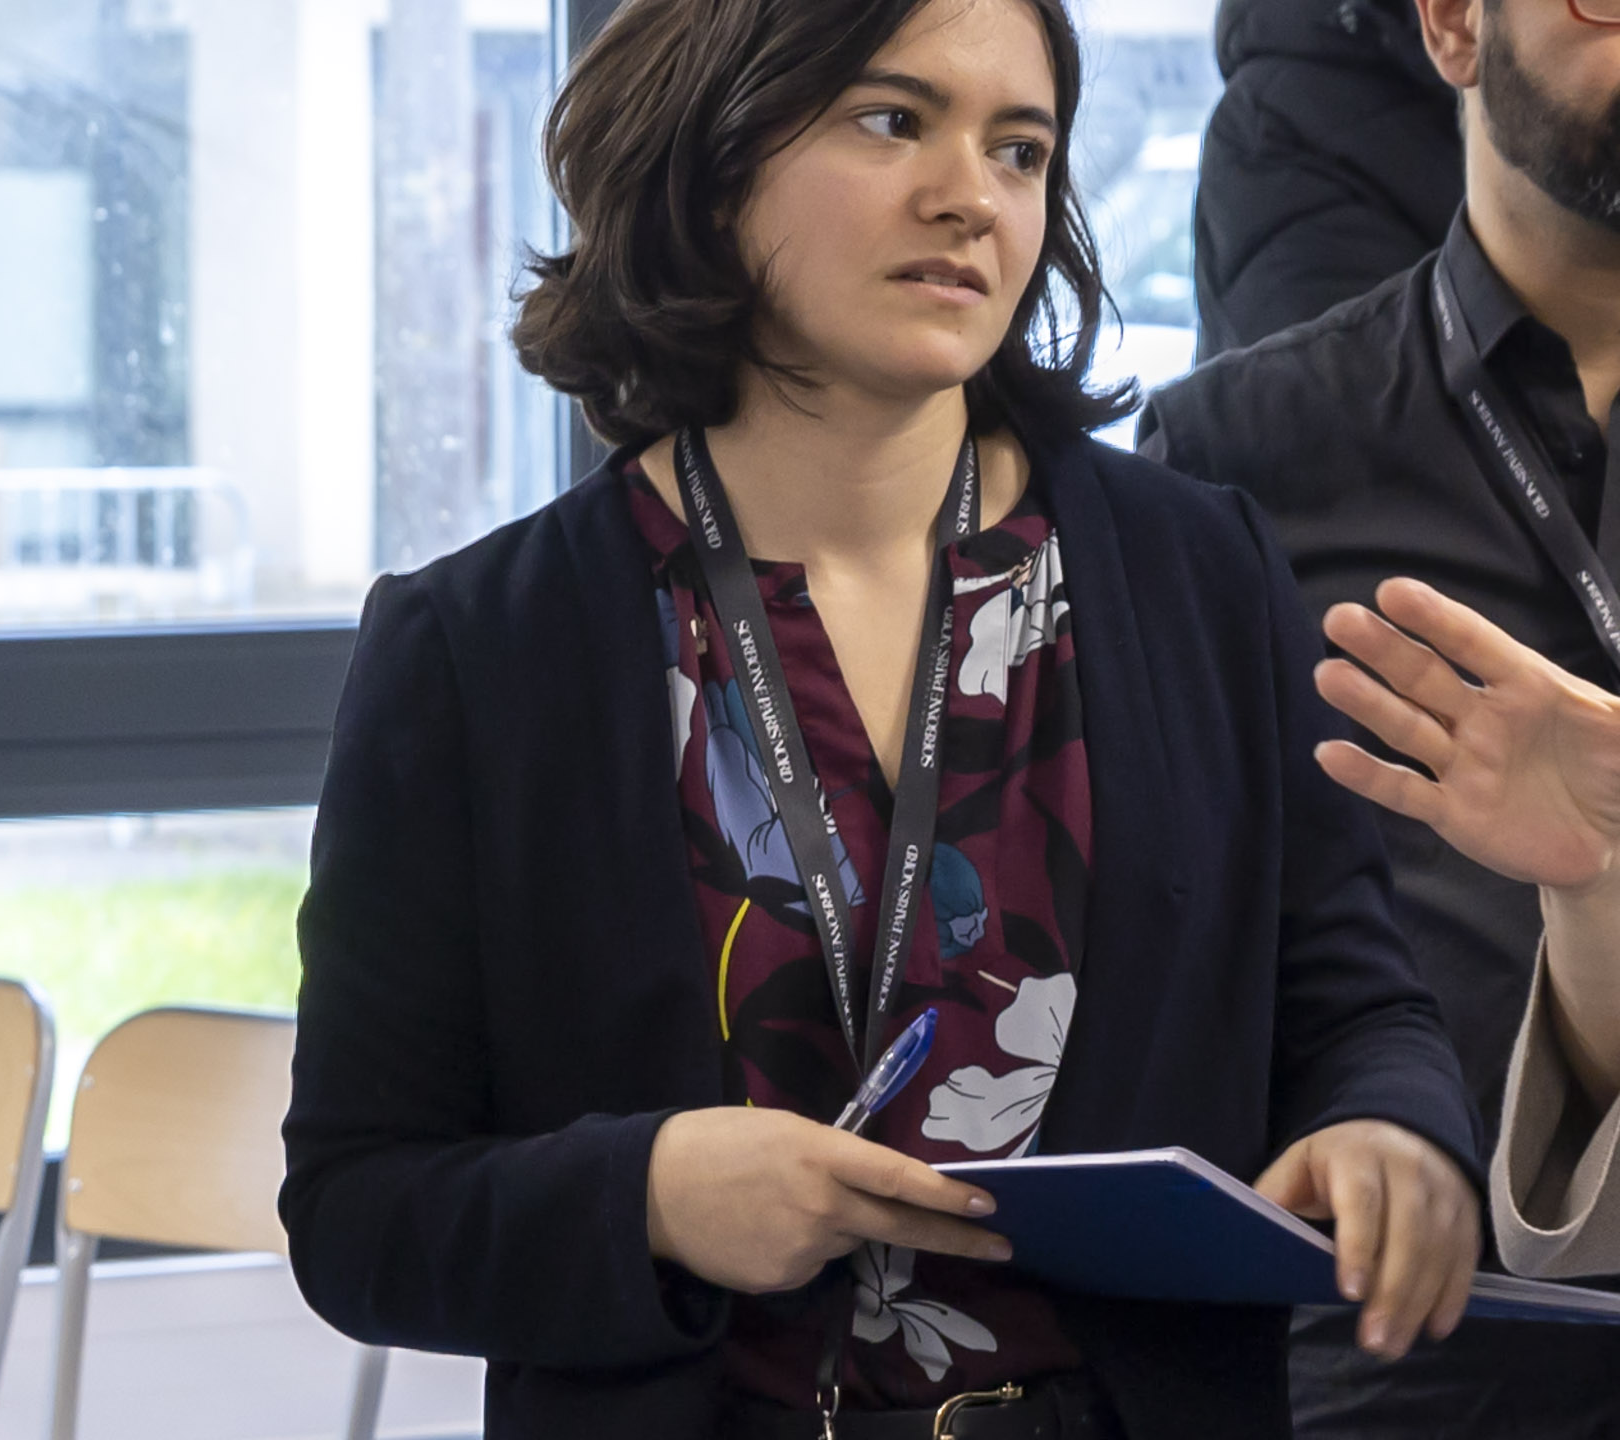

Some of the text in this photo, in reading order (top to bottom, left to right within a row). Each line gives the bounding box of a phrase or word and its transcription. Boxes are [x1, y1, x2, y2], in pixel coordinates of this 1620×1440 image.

[732, 618, 770, 698] SORBONNE
[755, 695, 782, 741] PARIS
[769, 737, 796, 785] NORD
[918, 691, 944, 769] SORBONNE
[931, 646, 951, 691] PARIS
[899, 843, 920, 889] NORD
[891, 888, 911, 934] PARIS
